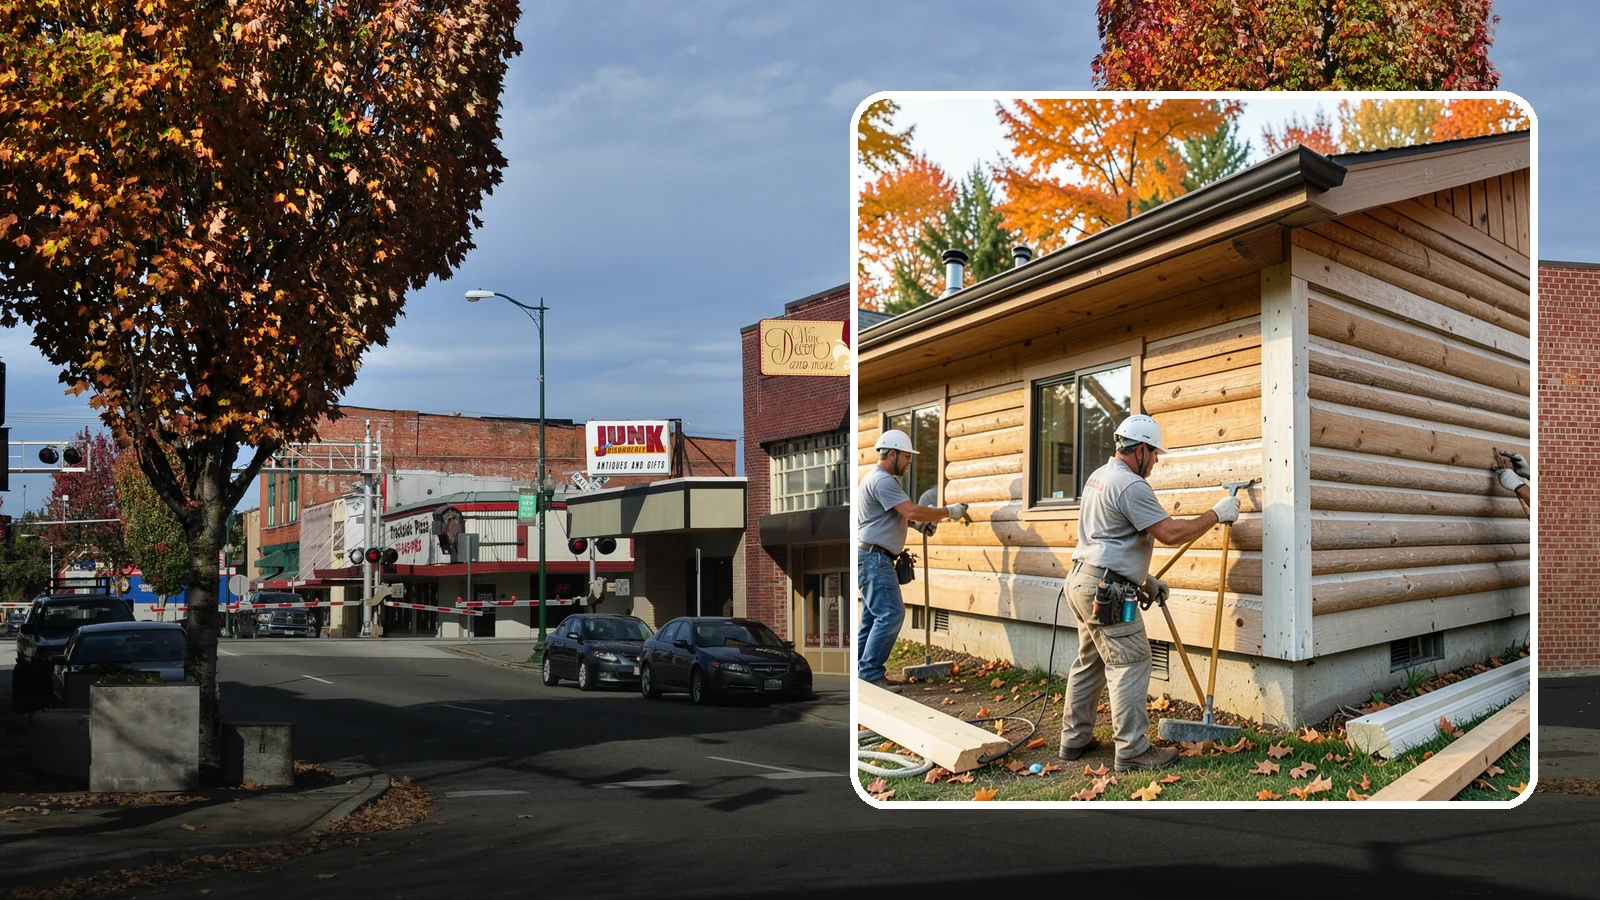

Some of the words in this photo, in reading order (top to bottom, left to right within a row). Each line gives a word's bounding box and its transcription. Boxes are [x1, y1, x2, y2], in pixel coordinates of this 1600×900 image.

[765, 327, 830, 365] Decor
[596, 425, 664, 457] JUNK
[597, 461, 628, 470] ANTIQUES
[631, 461, 643, 470] AND
[647, 461, 665, 470] GIFTS
[390, 521, 413, 540] Trackside
[414, 520, 429, 535] Pizza
